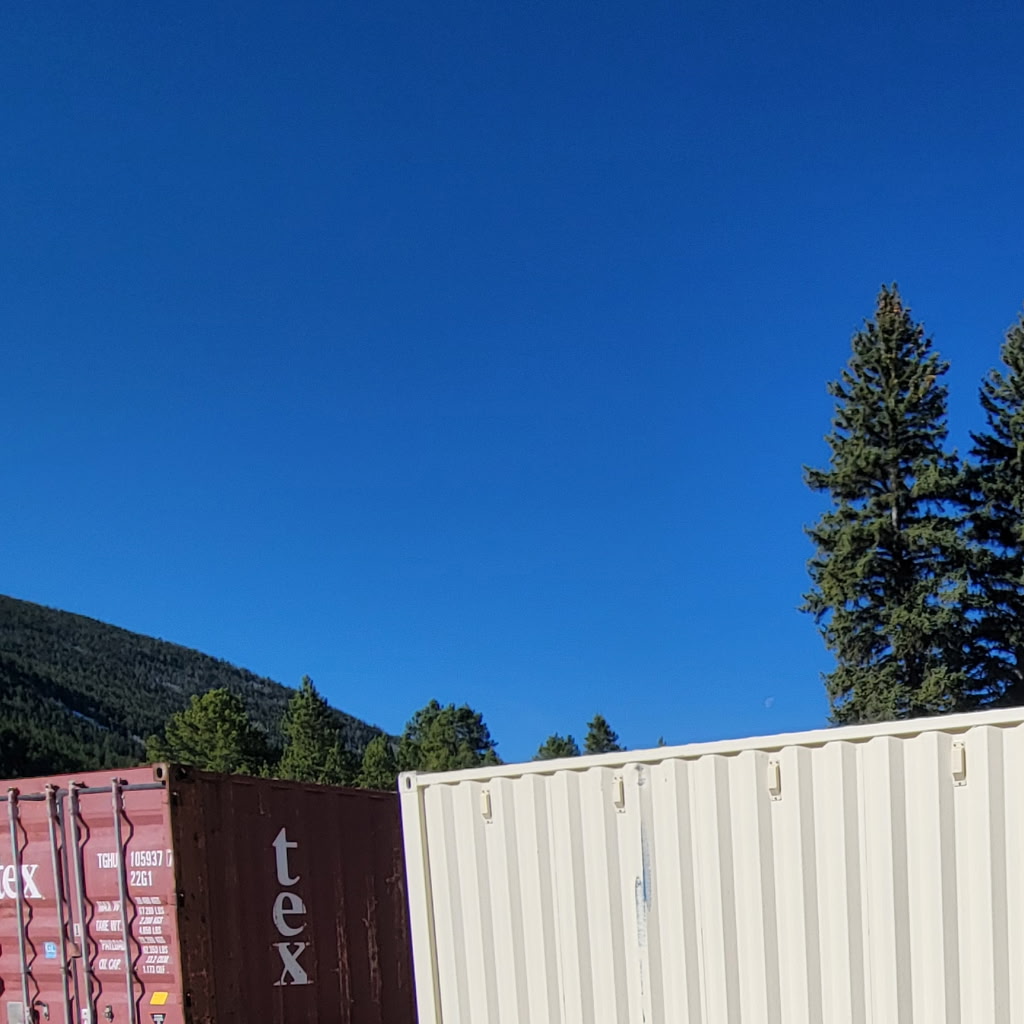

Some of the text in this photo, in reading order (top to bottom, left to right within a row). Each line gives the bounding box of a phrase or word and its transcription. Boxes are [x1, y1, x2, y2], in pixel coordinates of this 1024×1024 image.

[97, 853, 119, 869] TGHU
[130, 850, 163, 867] 105937
[0, 864, 42, 899] ex
[130, 871, 152, 886] 22G1
[272, 827, 314, 986] tex
